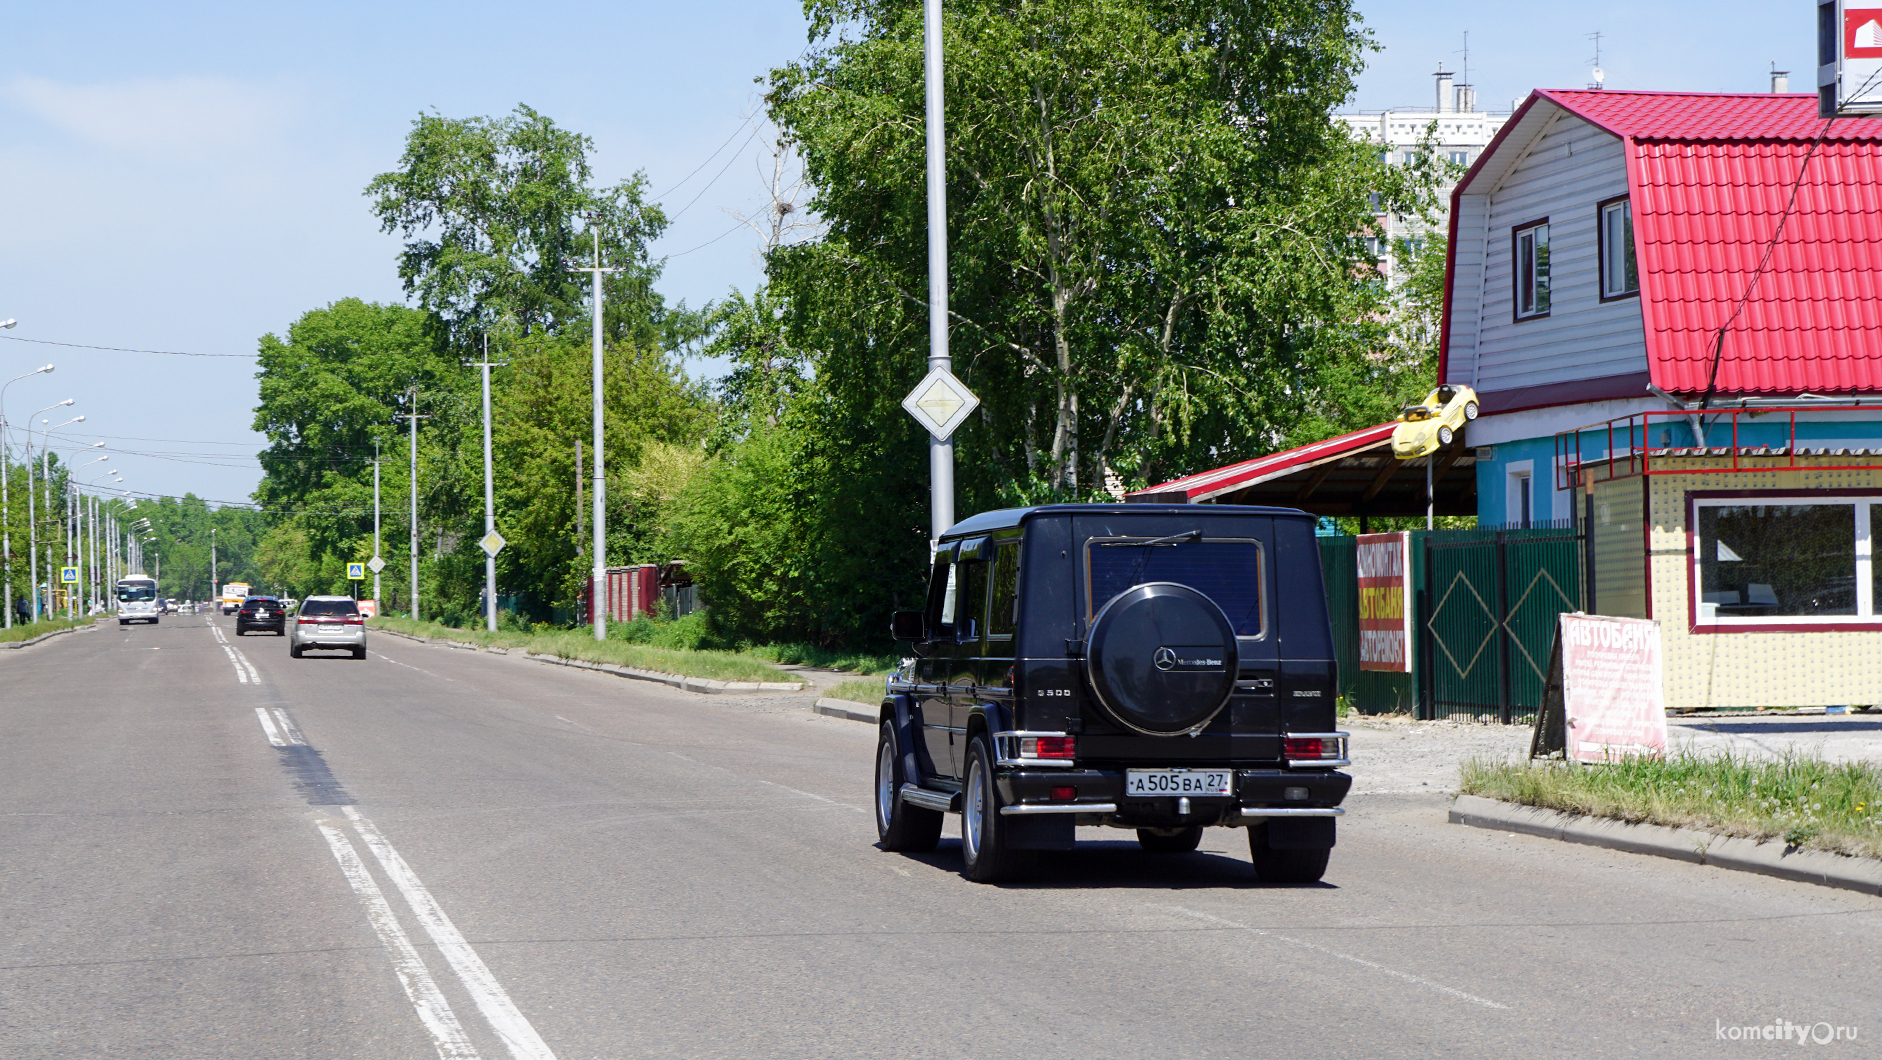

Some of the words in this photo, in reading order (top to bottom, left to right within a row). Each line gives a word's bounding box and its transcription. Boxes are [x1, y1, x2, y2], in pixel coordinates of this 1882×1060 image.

[1359, 587, 1404, 619] АВТОБАНЯ
[1360, 630, 1404, 663] АВТОРЕМОНТ
[1569, 619, 1655, 652] АВТОБАНЯ
[1177, 658, 1222, 666] Mercedes-Benz
[1207, 774, 1224, 787] 27
